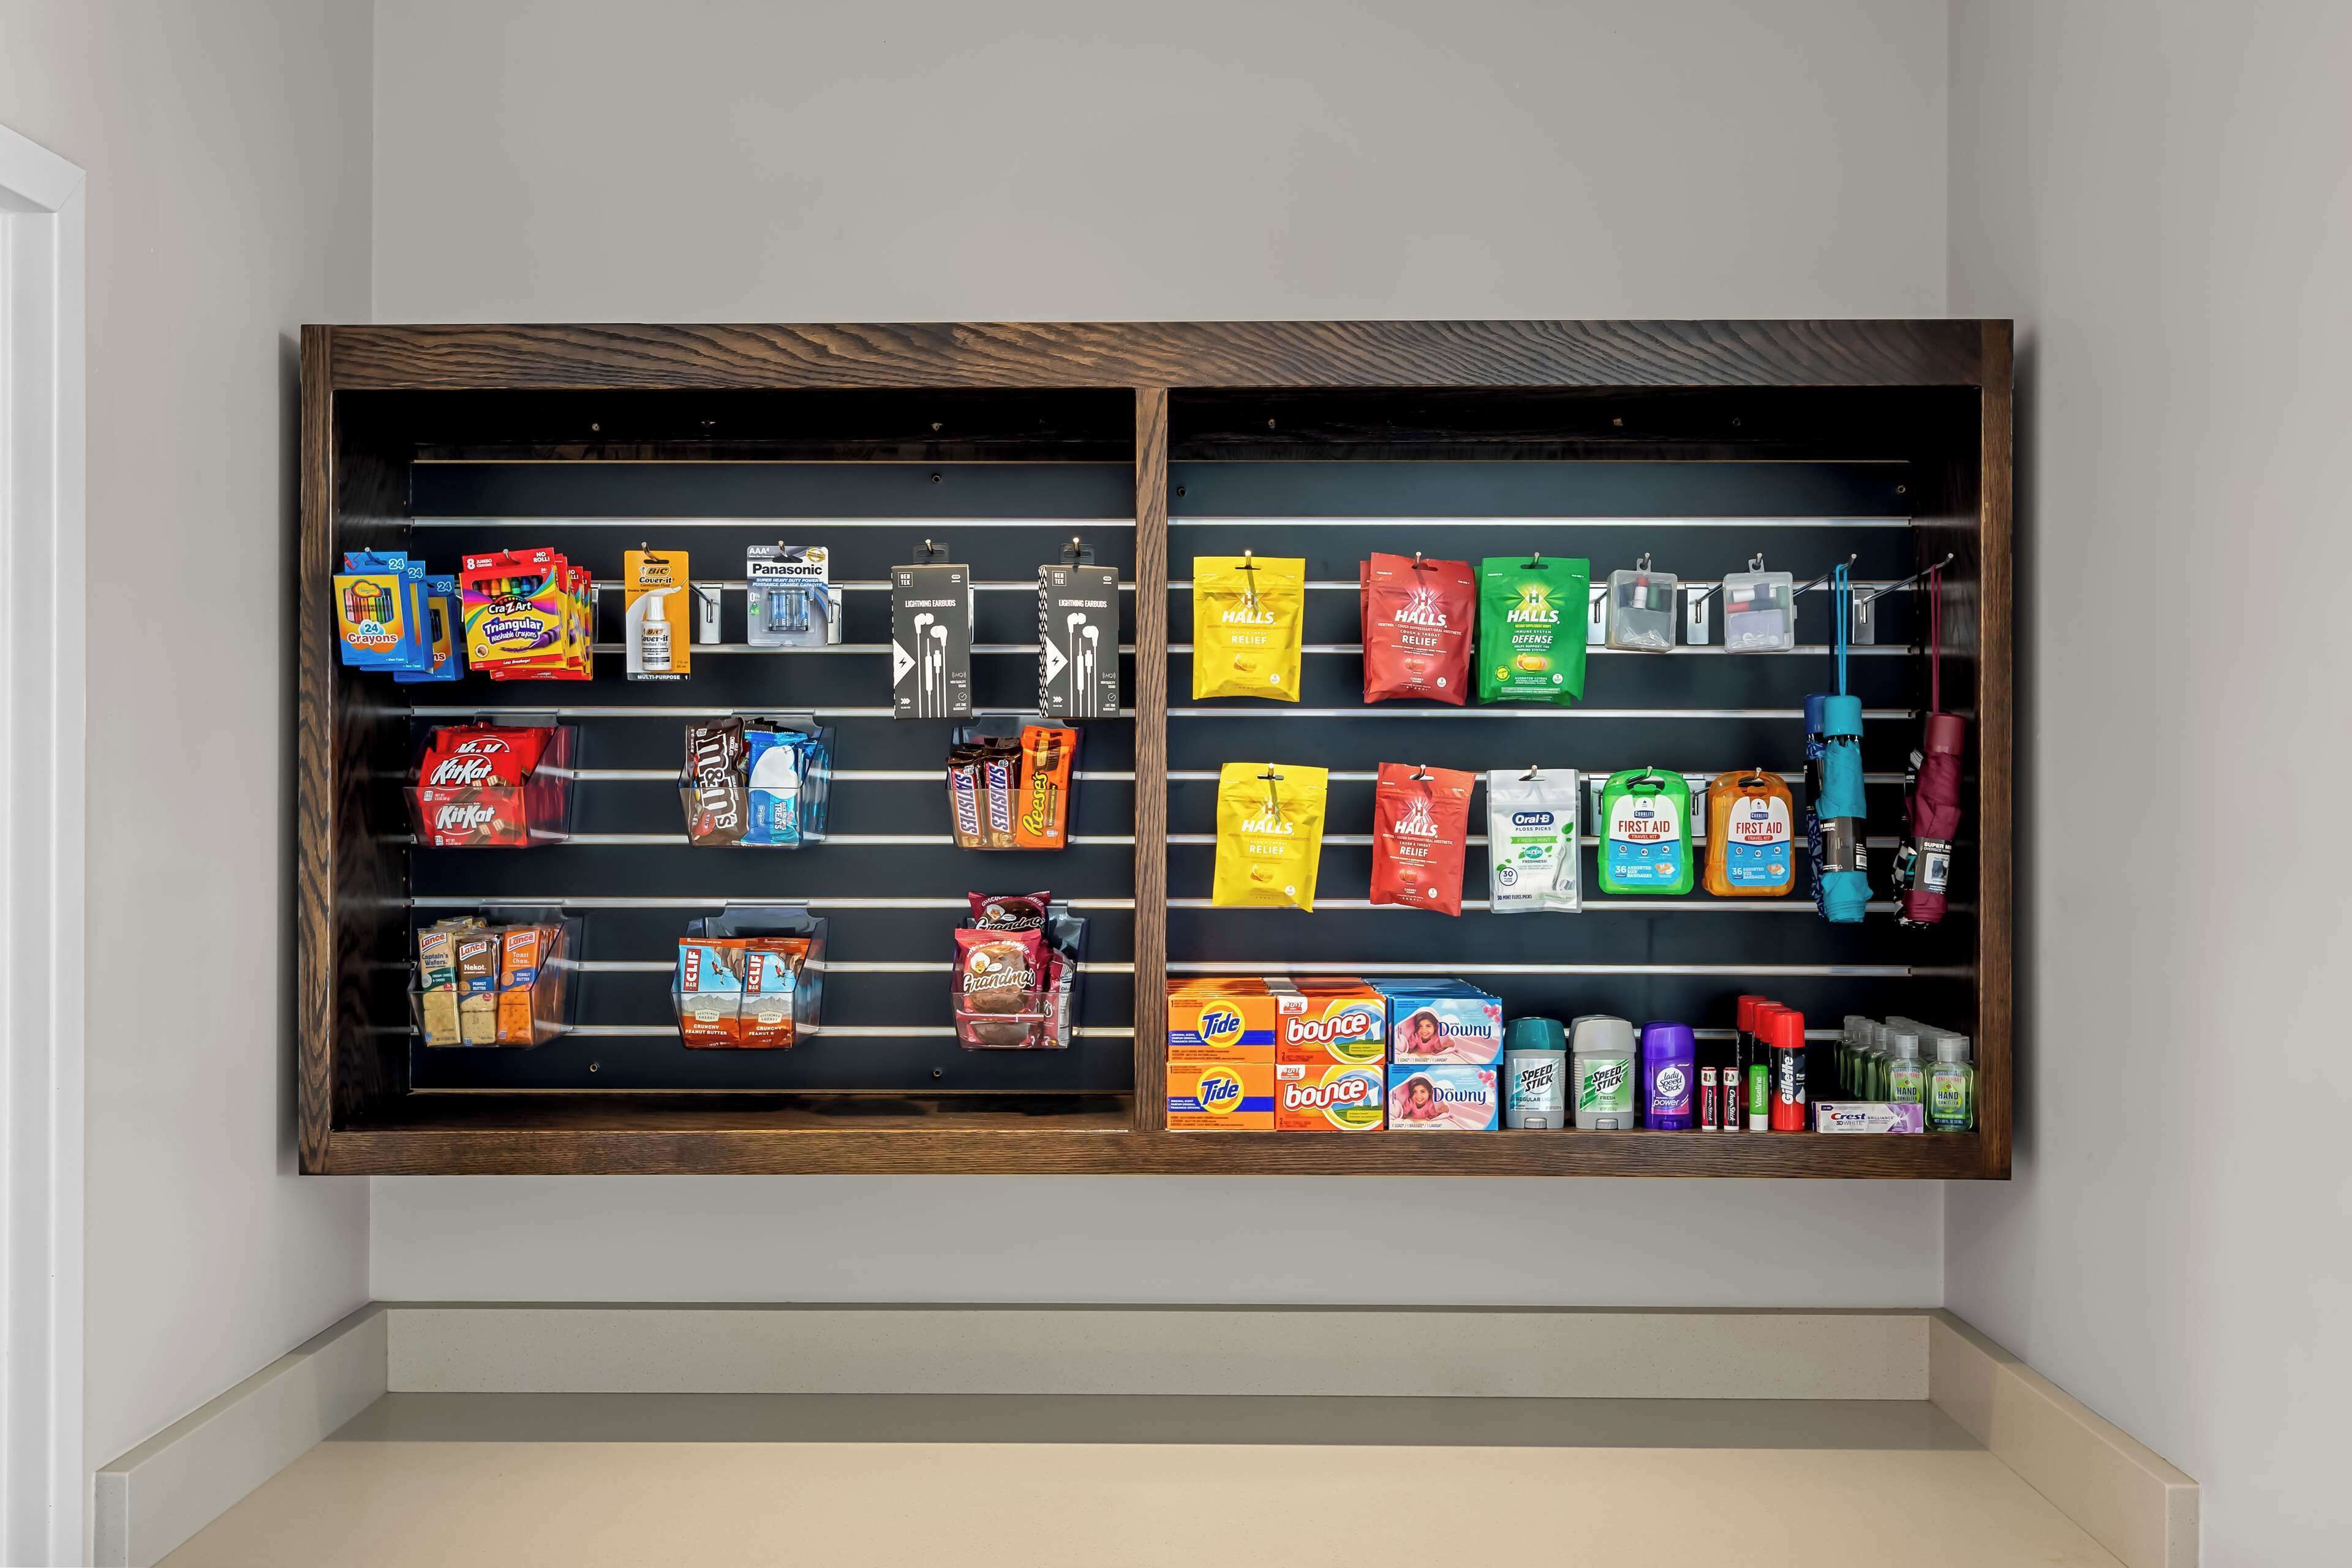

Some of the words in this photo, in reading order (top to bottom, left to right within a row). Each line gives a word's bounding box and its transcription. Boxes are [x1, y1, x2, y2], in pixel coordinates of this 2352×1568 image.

[389, 559, 404, 569] 24
[467, 558, 475, 570] 8
[753, 564, 823, 575] Panasonic
[409, 568, 423, 578] 24
[437, 582, 451, 592] 24
[1221, 611, 1275, 624] HALLS
[1394, 609, 1447, 627] HALLS
[1507, 610, 1559, 623] HALLS
[364, 624, 379, 632] 24
[484, 618, 541, 635] Triangular
[348, 633, 398, 645] Crayons
[491, 631, 514, 643] Washable
[1231, 635, 1267, 645] RELIEF
[1402, 635, 1438, 646] RELIEF
[1512, 635, 1553, 644] DEFENSE
[955, 772, 979, 835] SATISFIES
[989, 764, 1010, 832] SATISFIES
[774, 802, 783, 830] TREATS
[1515, 814, 1550, 824] Oral-B
[1241, 819, 1294, 834] HALLS
[1394, 821, 1439, 837] HALLS
[1618, 820, 1649, 832] FIRST
[1652, 820, 1670, 832] AID
[1736, 822, 1764, 834] FIRST
[1766, 822, 1782, 834] AID
[1249, 845, 1286, 855] RELIEF
[1400, 846, 1428, 857] RELIEF
[421, 934, 446, 949] Lance
[507, 934, 533, 948] Lance
[460, 942, 486, 956] Lance
[686, 951, 699, 981] CLIF
[748, 955, 763, 984] CLIF
[963, 967, 1036, 993] Grandma's
[1201, 1011, 1241, 1040] Tide
[1287, 1013, 1369, 1044] bounce
[1439, 1022, 1491, 1040] Downy
[1521, 1064, 1553, 1082] SPEED
[1593, 1065, 1623, 1083] SPEED
[1664, 1071, 1679, 1080] lady
[1525, 1074, 1553, 1093] STICK
[1596, 1075, 1623, 1092] STICK
[1659, 1076, 1682, 1088] Speed
[1781, 1056, 1794, 1105] Gillette
[1200, 1077, 1240, 1107] Tide
[1284, 1079, 1367, 1110] bounce
[1663, 1084, 1682, 1093] Stick
[1897, 1087, 1917, 1095] HAND
[1938, 1091, 1959, 1100] HAND
[1433, 1087, 1486, 1106] Downy
